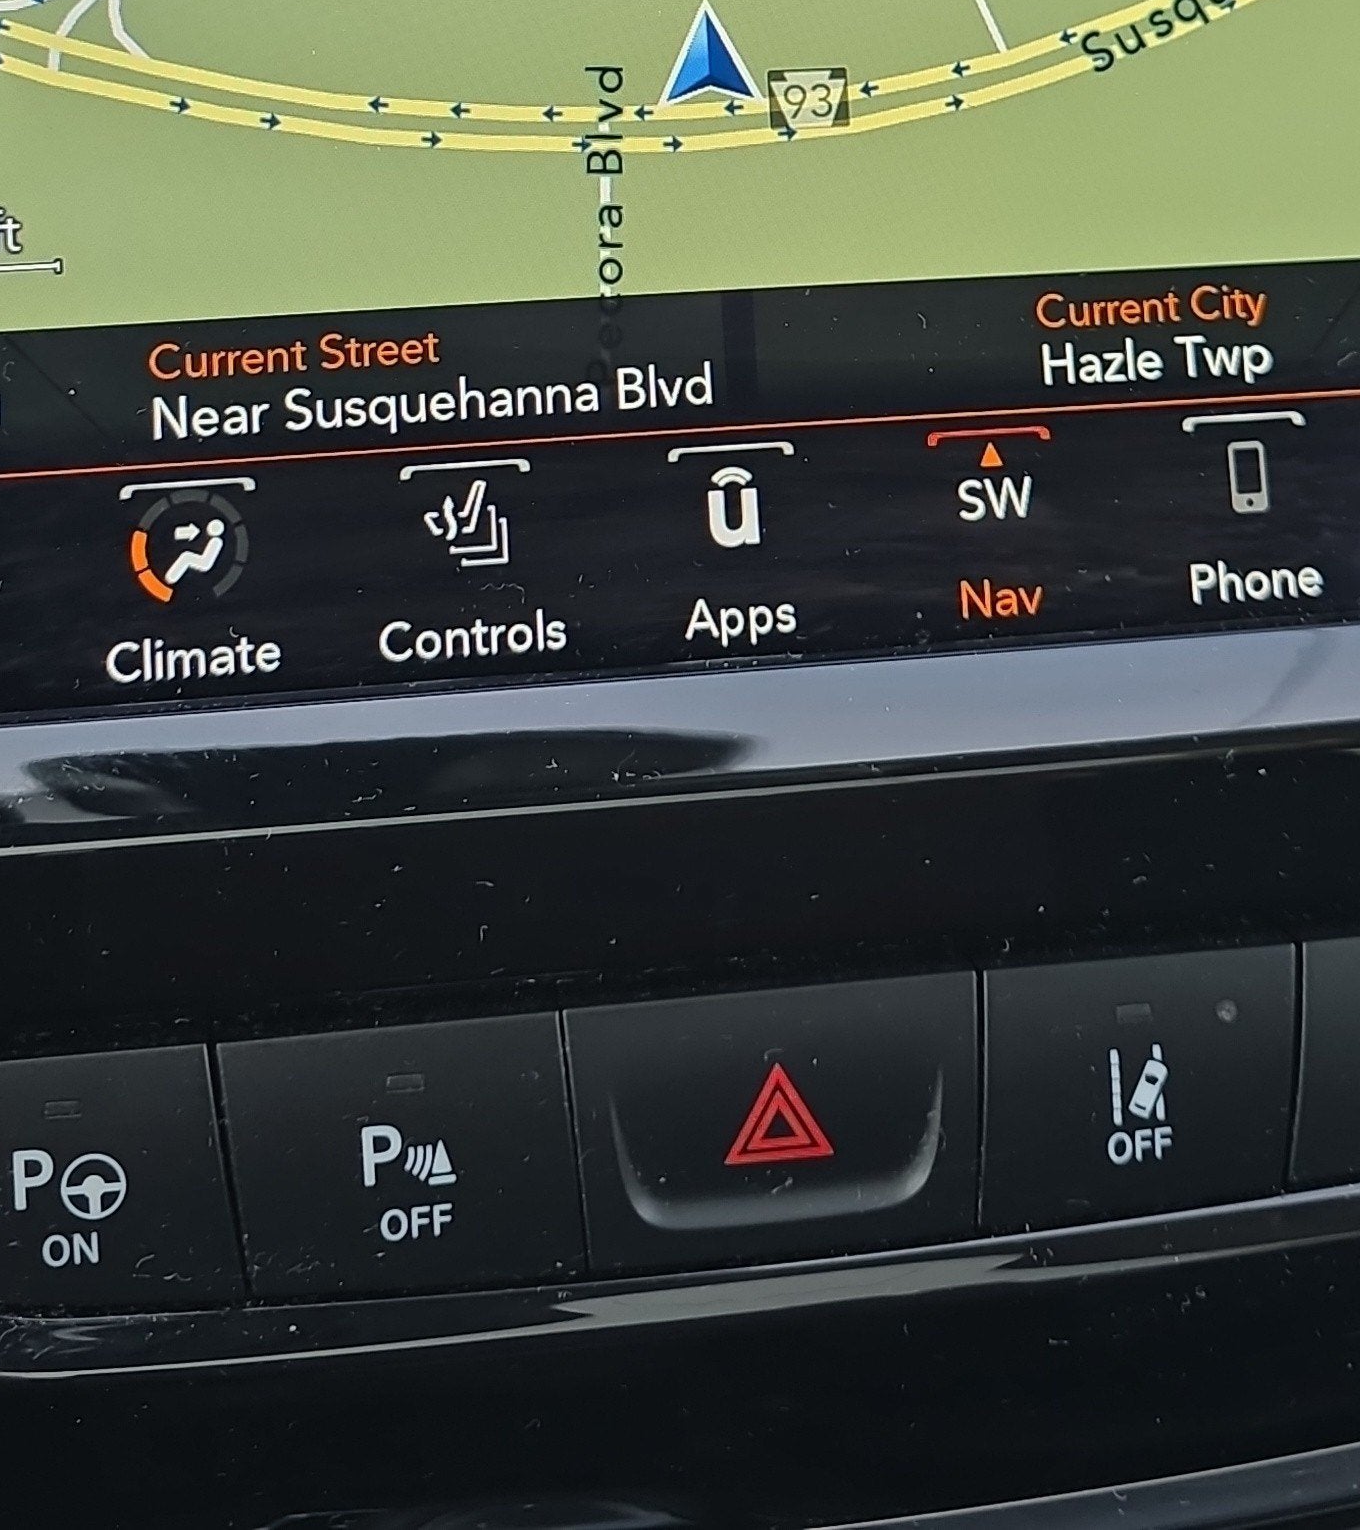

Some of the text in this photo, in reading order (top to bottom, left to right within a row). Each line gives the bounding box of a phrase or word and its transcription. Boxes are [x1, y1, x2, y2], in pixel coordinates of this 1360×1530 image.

[585, 66, 625, 176] Blvd
[783, 83, 833, 120] 93
[1036, 285, 1266, 328] Current City
[148, 333, 440, 380] Current Street
[1041, 335, 1274, 386] Hazle Twp
[152, 360, 713, 441] Near Susquehanna Blvd
[957, 475, 1032, 521] SW
[960, 578, 1042, 619] Nav
[1189, 560, 1324, 605] Phone
[378, 608, 567, 663] Controls
[684, 598, 797, 646] Apps
[105, 636, 282, 684] Climate
[360, 1124, 402, 1187] P
[1107, 1126, 1173, 1165] OFF
[12, 1149, 54, 1211] P
[380, 1202, 453, 1242] OFF
[41, 1231, 100, 1268] ON
